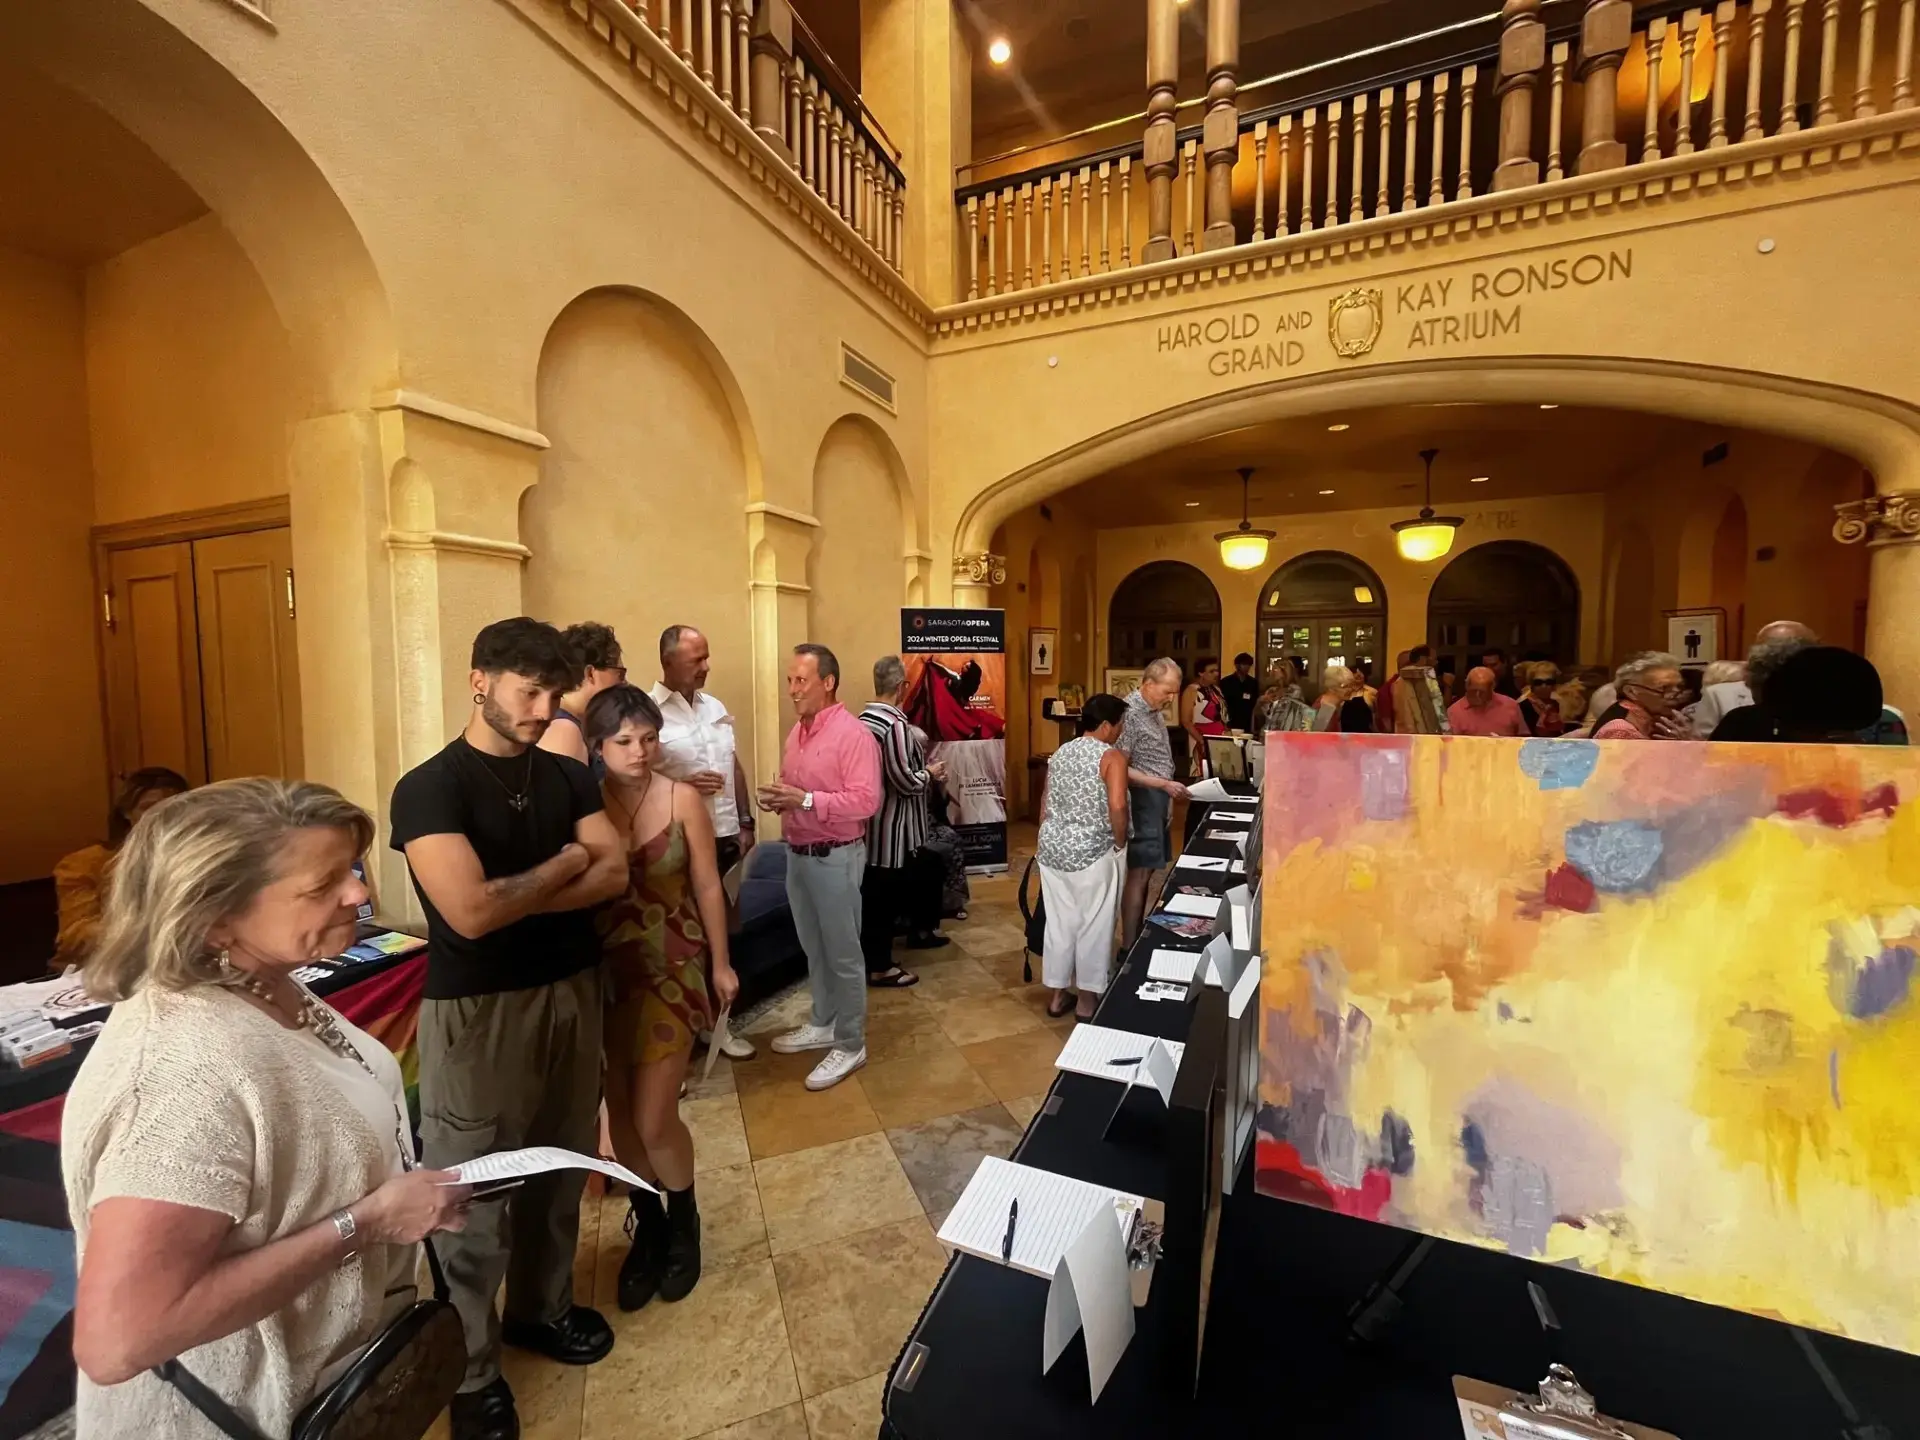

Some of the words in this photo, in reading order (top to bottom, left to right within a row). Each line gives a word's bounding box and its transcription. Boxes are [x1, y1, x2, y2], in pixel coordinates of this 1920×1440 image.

[1157, 312, 1260, 352] HAROLD
[1276, 311, 1313, 334] AND
[1397, 277, 1454, 314] KAY
[1471, 248, 1633, 302] RONSON
[1208, 341, 1305, 377] GRAND
[1407, 305, 1521, 349] ATRIUM
[907, 635, 924, 643] 2024
[925, 635, 949, 643] WINTER
[950, 635, 971, 643] OPERA
[972, 635, 999, 643] FESTIVAL
